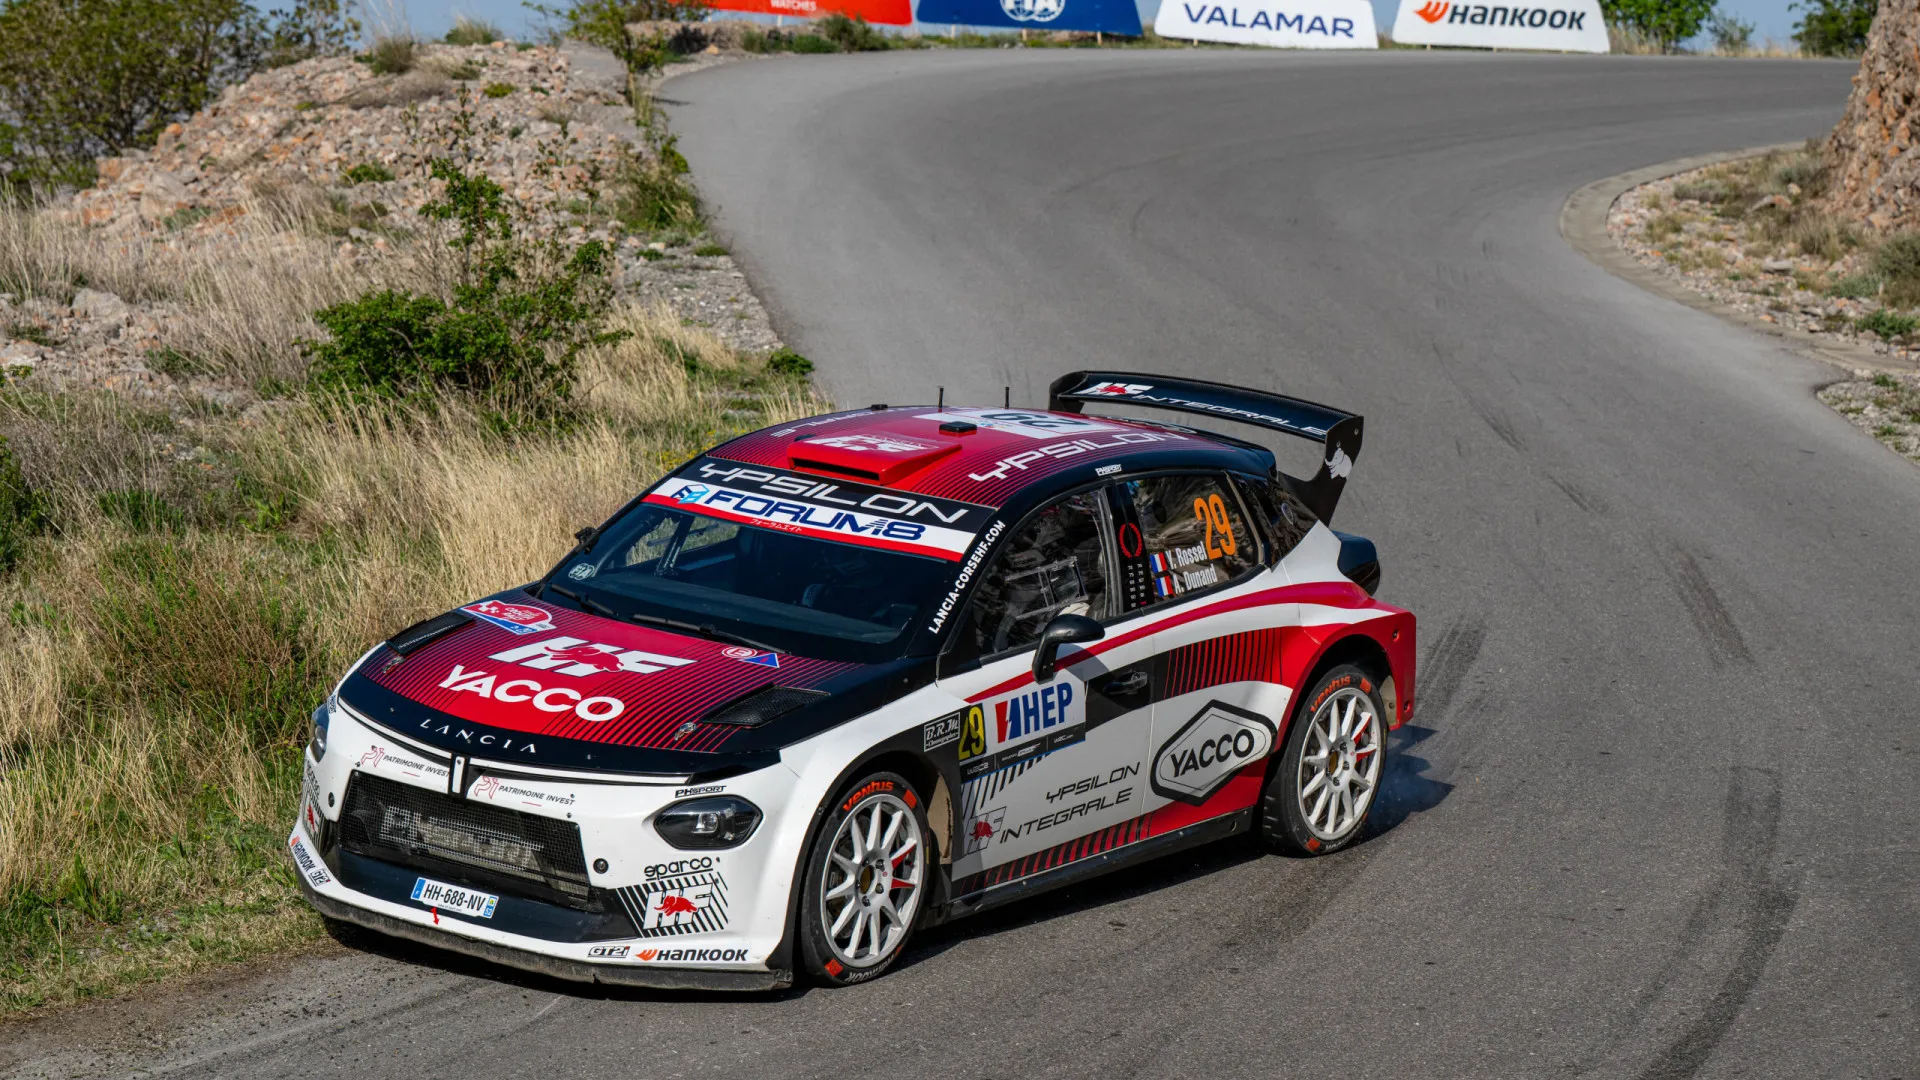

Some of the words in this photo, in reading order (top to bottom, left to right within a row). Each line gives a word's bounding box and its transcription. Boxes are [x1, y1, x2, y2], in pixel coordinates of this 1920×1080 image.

[1184, 3, 1355, 38] VALAMAR
[1131, 394, 1328, 437] INTEGRALE
[968, 432, 1188, 482] YPSILON
[699, 463, 969, 523] YPSILON
[704, 490, 926, 541] FORUM8
[1193, 493, 1236, 560] 29
[1165, 550, 1177, 570] Y.
[1175, 540, 1208, 568] Rossel
[928, 519, 1006, 635] LANCIA-CORSEHF.COM
[1172, 574, 1185, 594] A.
[1183, 563, 1218, 591] Dunand
[437, 664, 626, 722] YACCO
[419, 718, 537, 754] LANCIA
[958, 706, 985, 761] 29
[1169, 728, 1256, 779] YACCO
[383, 754, 424, 771] PATRIMOINE
[1046, 762, 1141, 804] YPSILON
[498, 785, 546, 799] PATRIMOINE
[546, 794, 575, 805] INVEST
[1000, 787, 1134, 844] INTEGRALE
[644, 857, 713, 880] sparco
[423, 883, 486, 912] HH-688-NV
